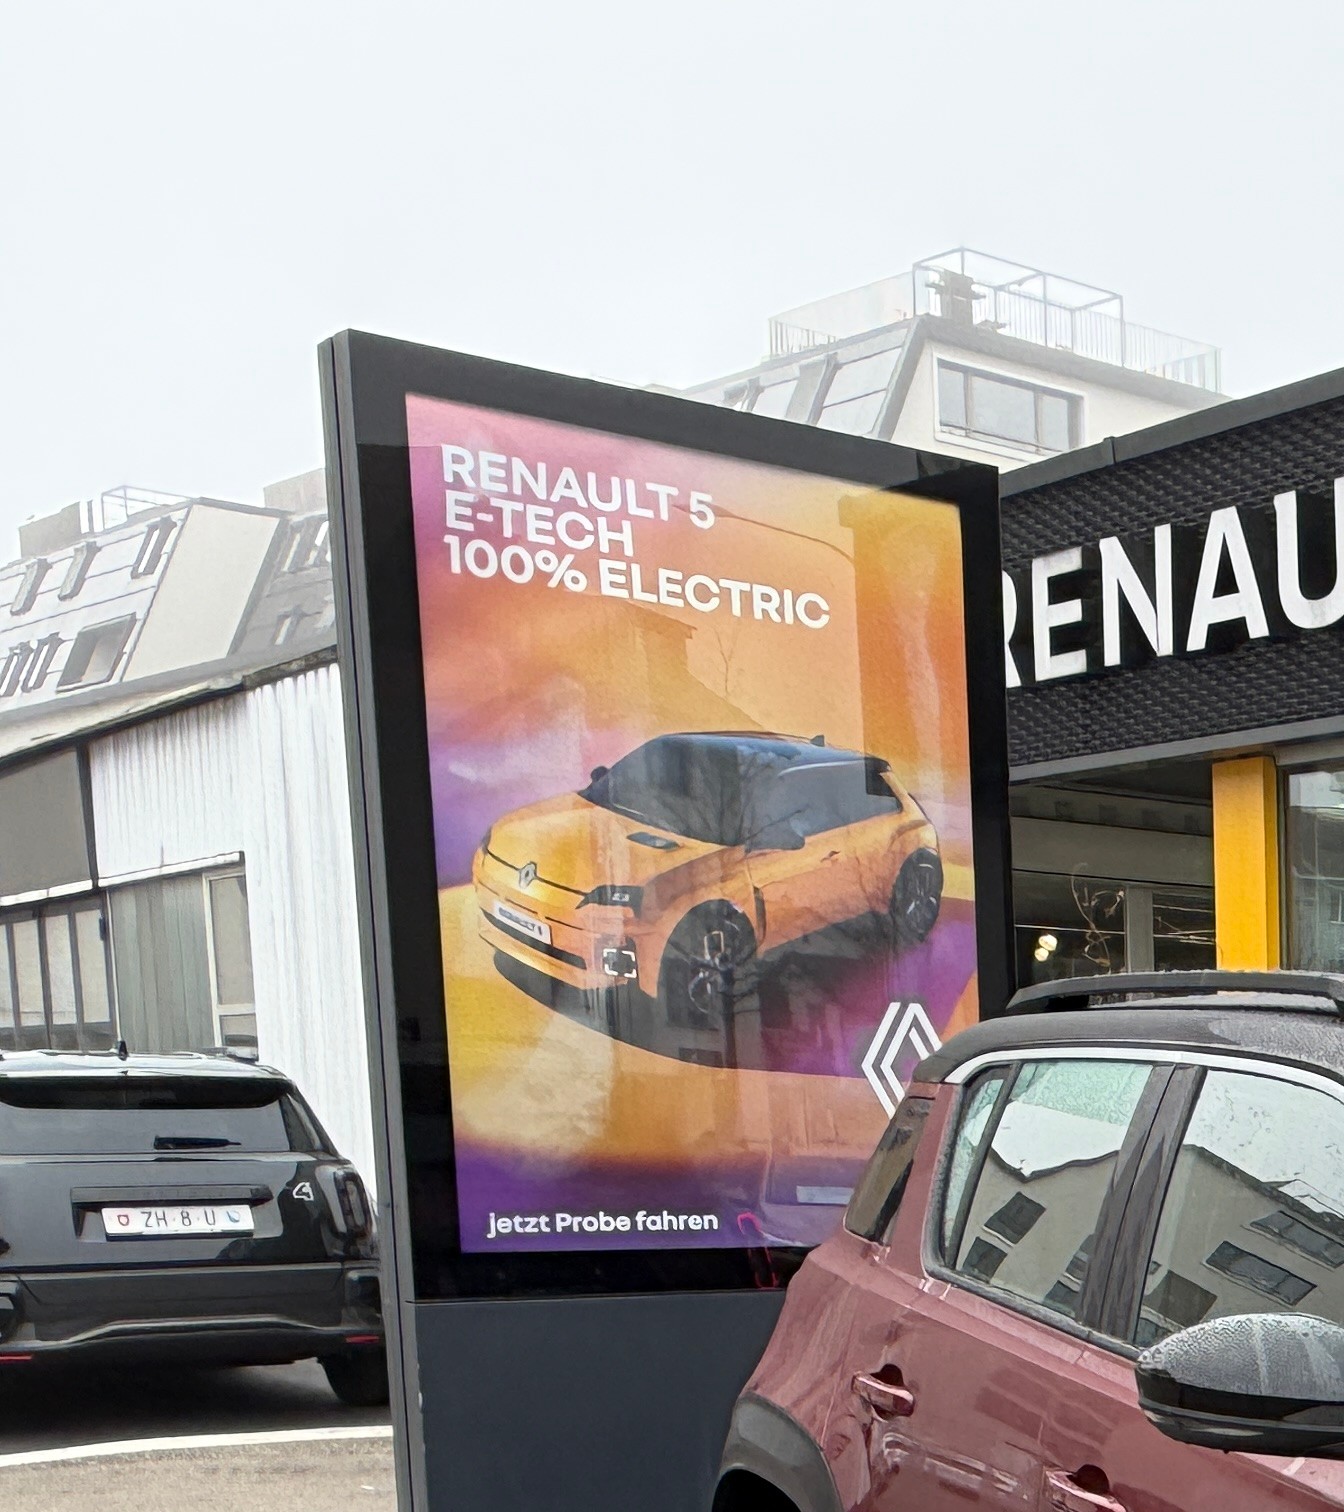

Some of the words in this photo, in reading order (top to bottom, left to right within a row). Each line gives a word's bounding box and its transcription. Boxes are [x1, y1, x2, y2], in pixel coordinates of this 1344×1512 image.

[441, 444, 678, 521] RENAULT
[689, 491, 716, 530] 5
[446, 489, 634, 557] E-TECH
[443, 534, 587, 592] 100%
[599, 558, 830, 629] ELECTRIC
[486, 1212, 550, 1239] jetzt
[555, 1211, 631, 1233] Probe
[635, 1210, 719, 1232] fahren
